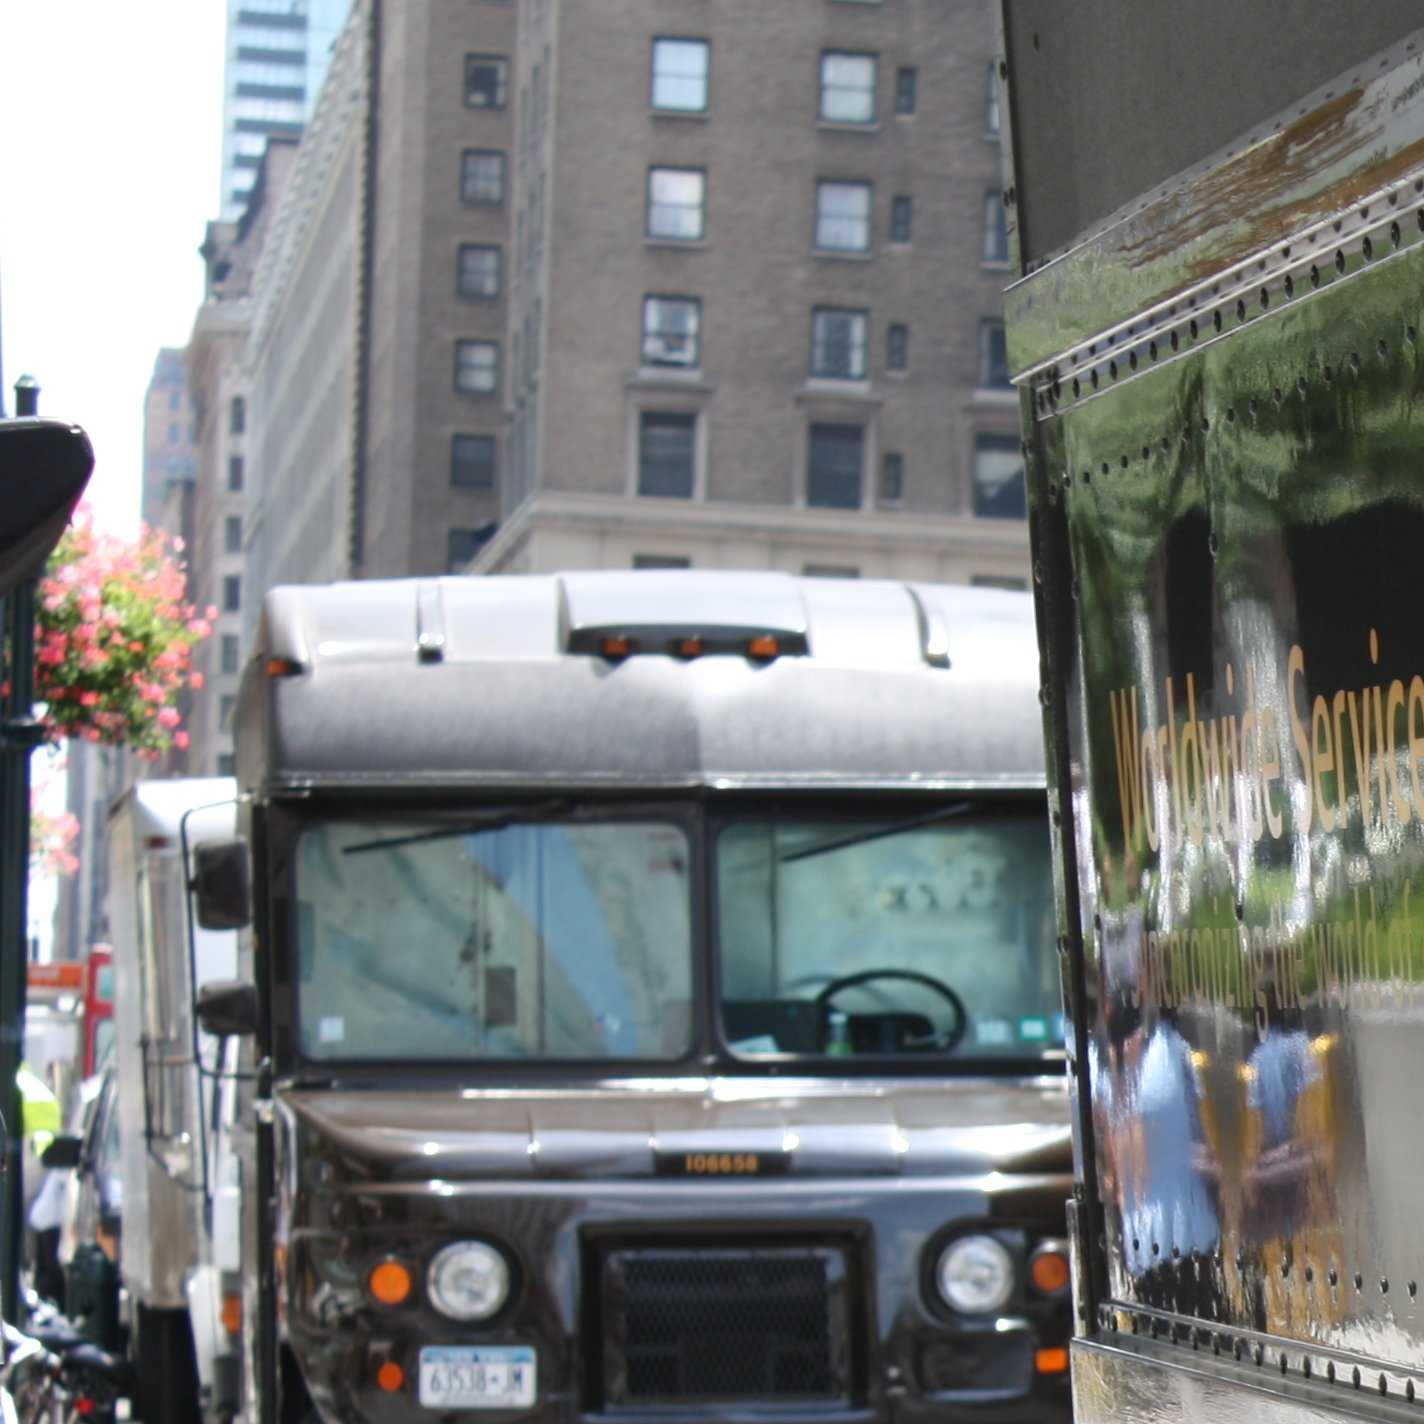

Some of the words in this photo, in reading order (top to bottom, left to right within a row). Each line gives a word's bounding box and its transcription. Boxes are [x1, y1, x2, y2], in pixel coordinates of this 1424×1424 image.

[1109, 663, 1283, 852] Worldwide
[1267, 893, 1309, 1010] the
[1310, 884, 1380, 1010] world
[1388, 878, 1413, 1008] of
